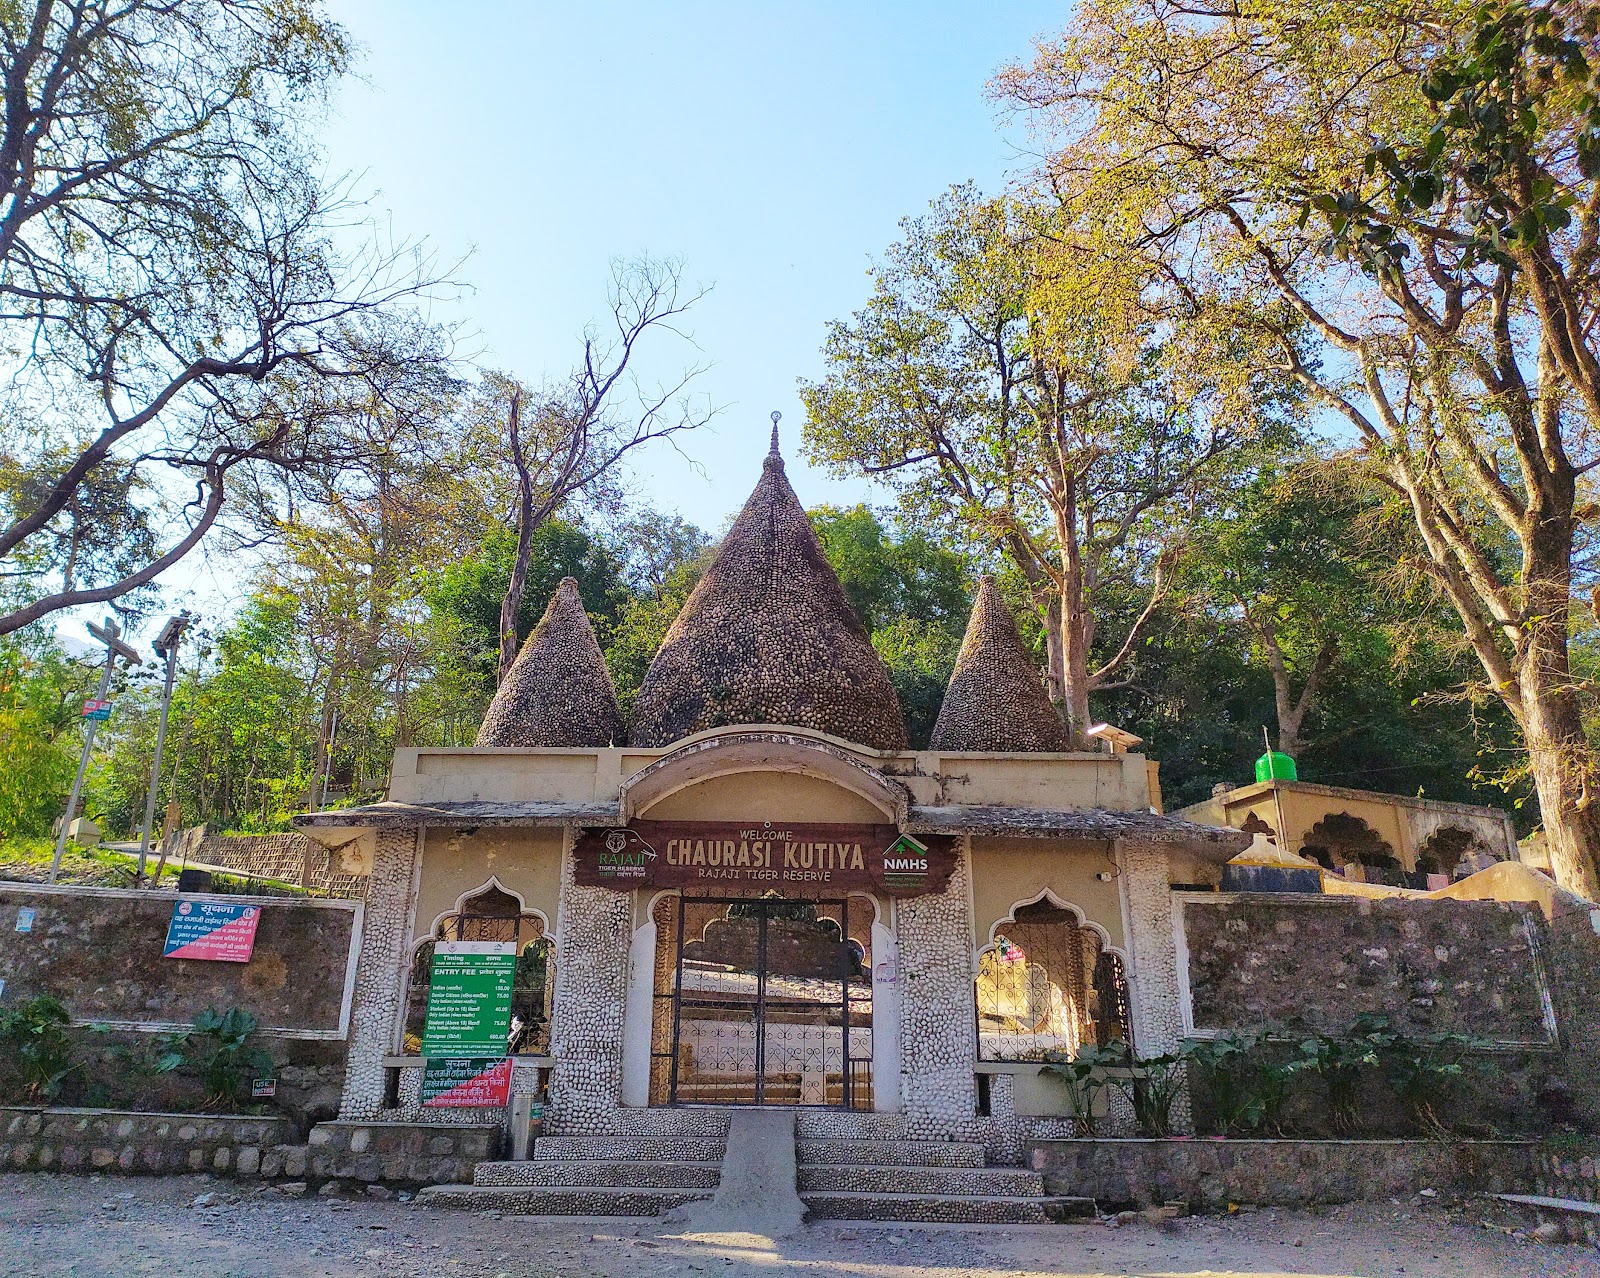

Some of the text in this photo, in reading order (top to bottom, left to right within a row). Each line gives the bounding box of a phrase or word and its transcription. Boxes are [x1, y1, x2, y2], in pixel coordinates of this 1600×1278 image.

[739, 830, 793, 841] WELCOME
[600, 854, 644, 865] RAJAJI
[666, 840, 865, 870] CHAURASI KUTIYA
[884, 858, 928, 870] NMHS
[698, 868, 831, 882] RAJAJI TIGER RESERVE
[201, 904, 235, 916] सूचना
